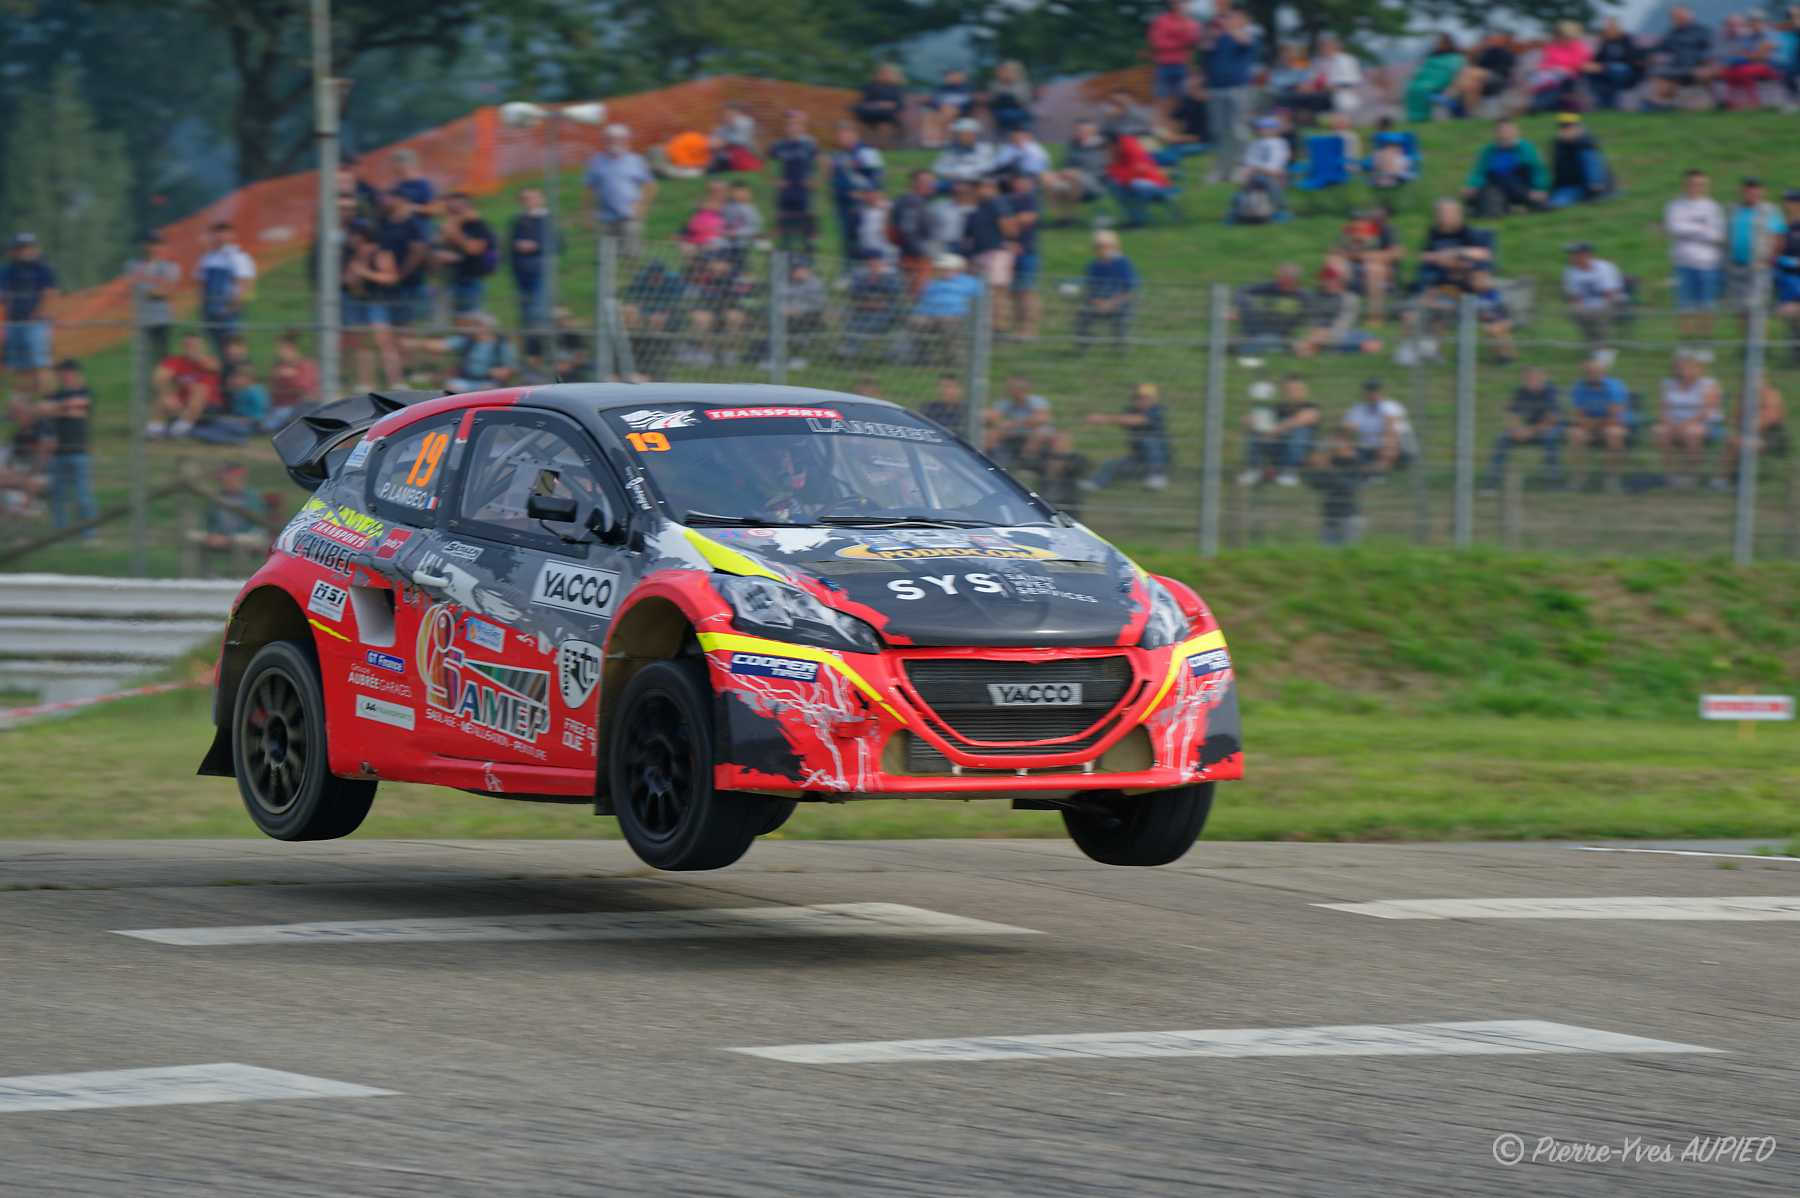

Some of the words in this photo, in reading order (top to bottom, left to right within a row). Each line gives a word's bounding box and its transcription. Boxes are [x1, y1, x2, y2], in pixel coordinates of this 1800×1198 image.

[625, 431, 672, 452] 19
[406, 432, 448, 488] 19
[292, 531, 357, 577] LAMBEC
[543, 570, 612, 609] YACCO
[887, 573, 1001, 600] SYS
[732, 653, 817, 673] COOPER
[771, 668, 815, 680] TIRES
[997, 684, 1072, 704] YACCO
